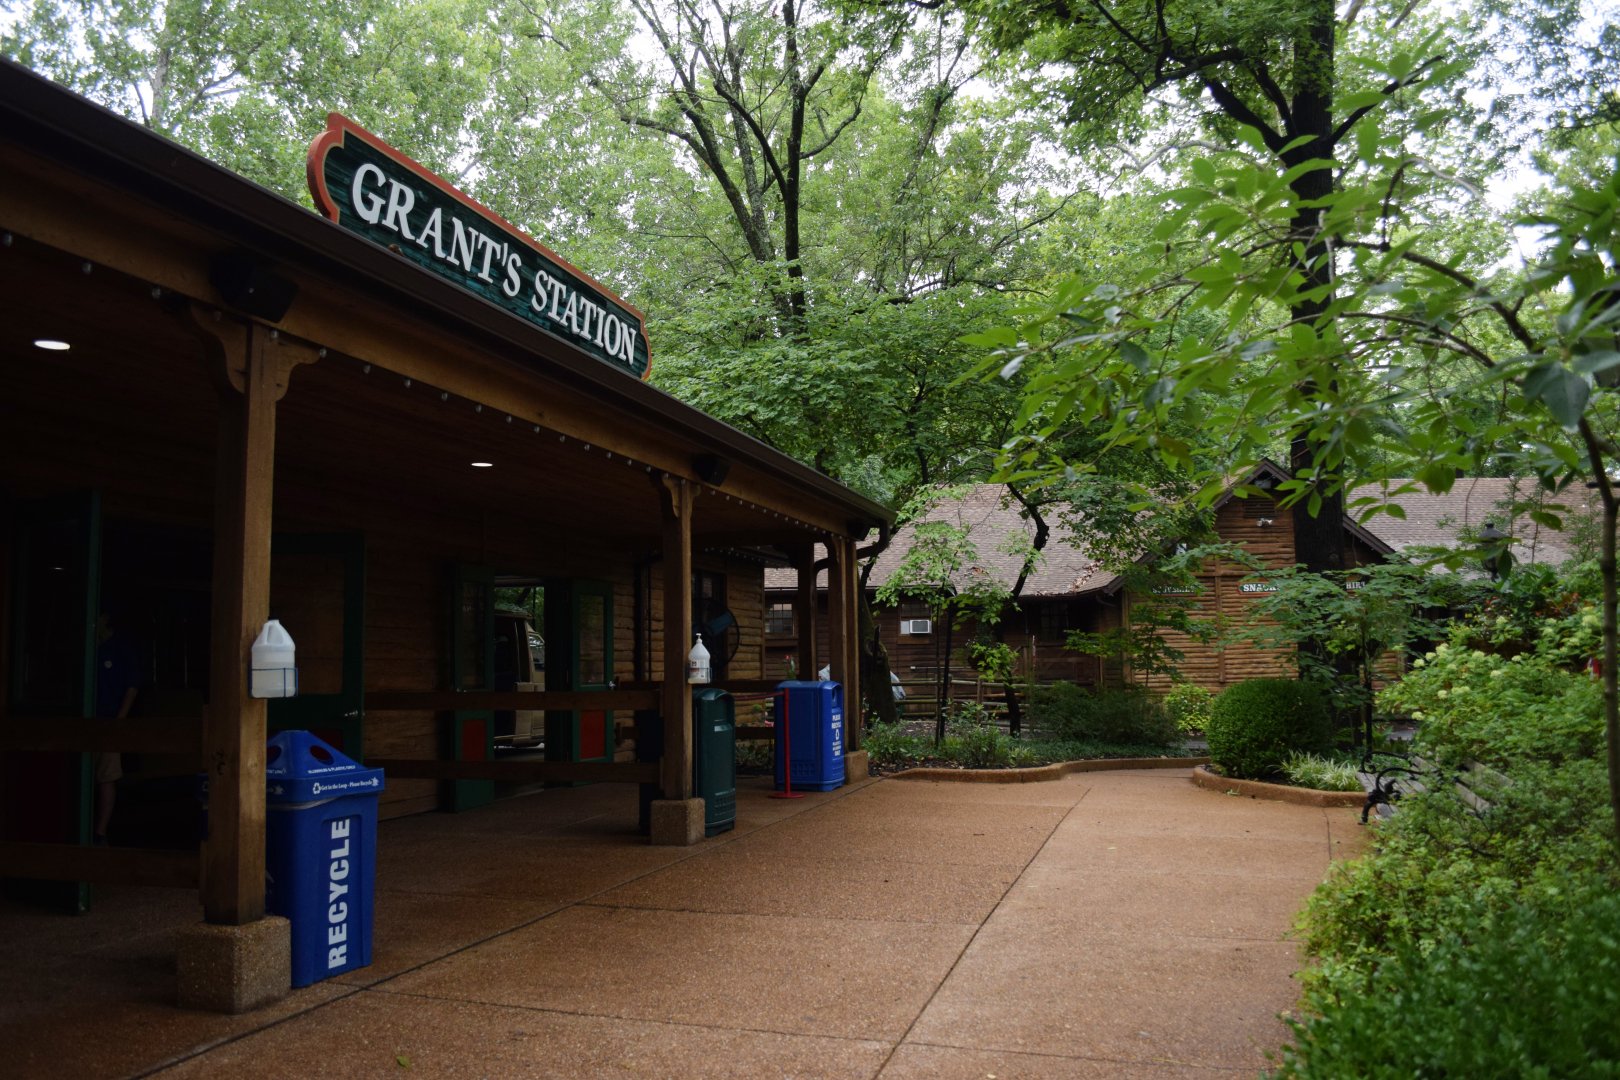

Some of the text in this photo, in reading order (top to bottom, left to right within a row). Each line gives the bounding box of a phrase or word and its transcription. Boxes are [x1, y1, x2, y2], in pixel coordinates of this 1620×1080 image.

[352, 163, 636, 365] GRANT'S STATION
[328, 818, 350, 970] RECYCLE
